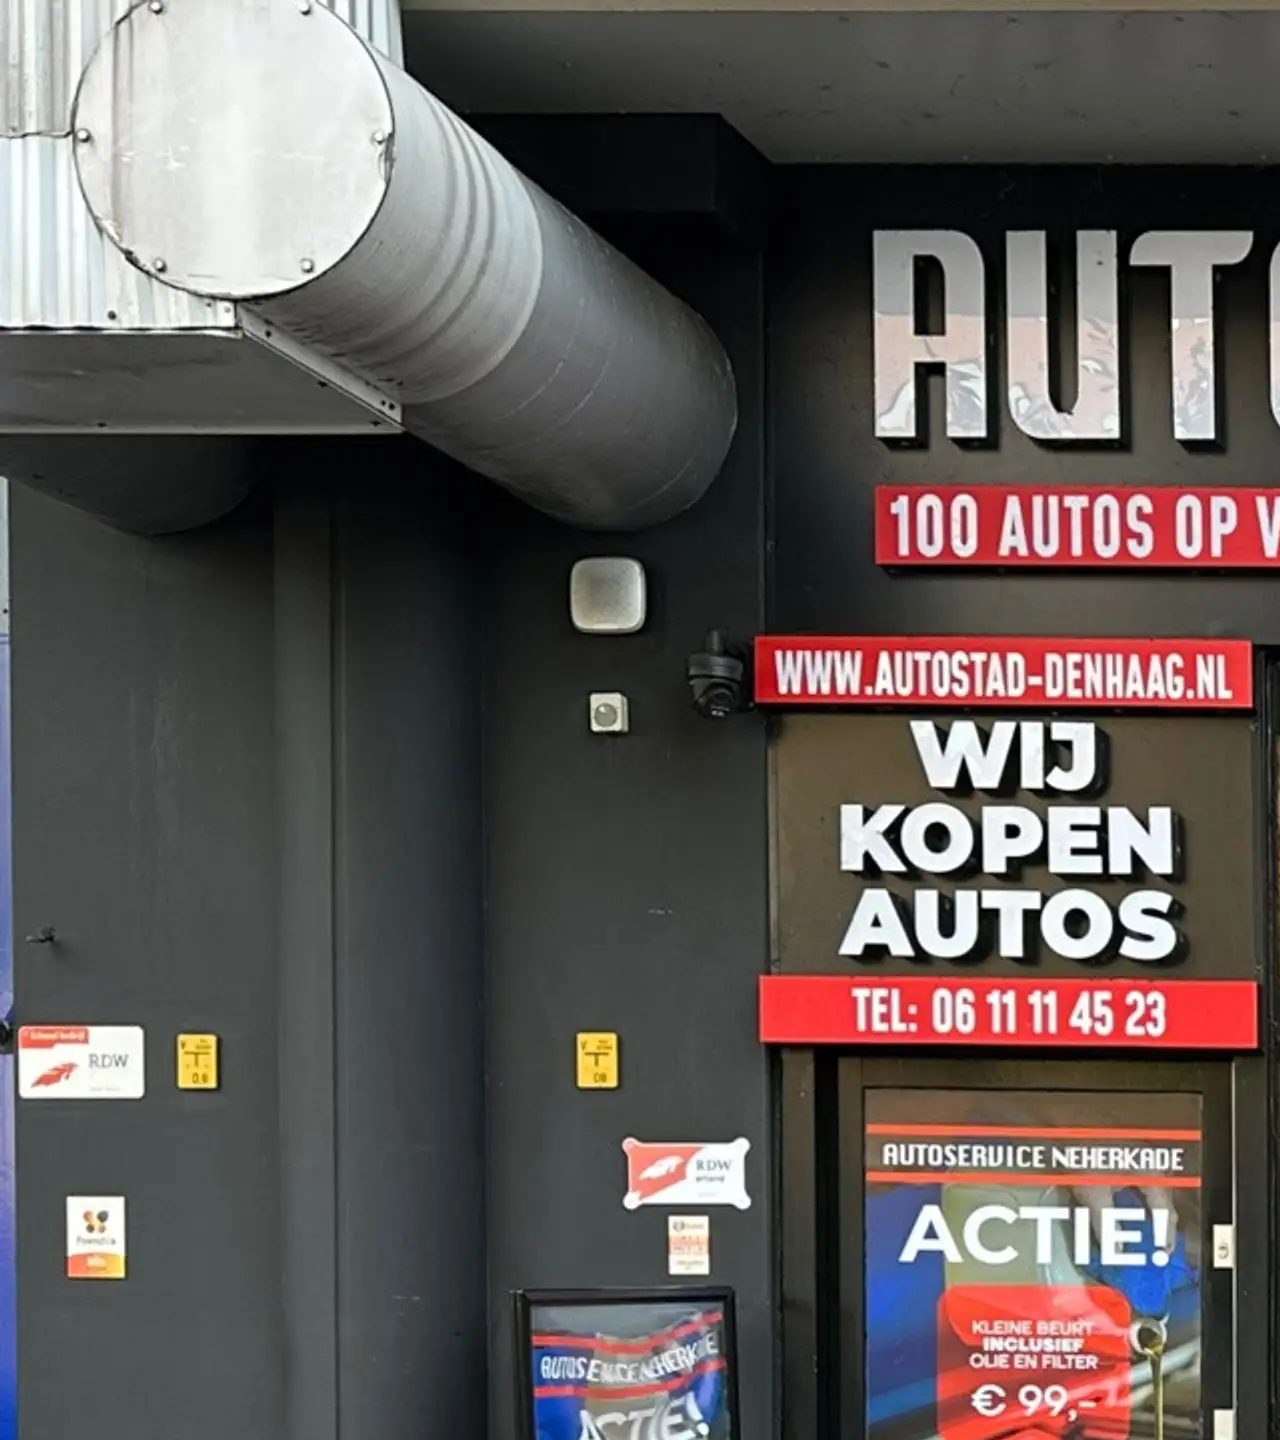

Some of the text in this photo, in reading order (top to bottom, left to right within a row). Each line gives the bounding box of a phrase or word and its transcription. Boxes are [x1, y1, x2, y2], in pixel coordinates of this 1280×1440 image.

[890, 493, 979, 560] 100
[999, 494, 1155, 560] AUTOS
[1175, 495, 1236, 561] OP
[775, 650, 1232, 700] WWW.AUTOSTAD-DENHAAG.NL
[910, 720, 1097, 791] WIJ
[839, 803, 1173, 875] KOPEN
[839, 888, 1177, 960] AUTOS
[852, 987, 1166, 1036] TEL: 06 11 11 45 23
[88, 1053, 129, 1069] RDW
[696, 1159, 732, 1171] RDW
[883, 1143, 1184, 1172] AUTOSERVICE NEHERKADE
[899, 1203, 1170, 1267] ACTIE!
[971, 1320, 1094, 1335] KLEINE BEURT
[982, 1337, 1085, 1353] INCLUSIEF
[969, 1353, 1098, 1370] OLIE EN FILTER
[971, 1383, 1097, 1422] € 99,-
